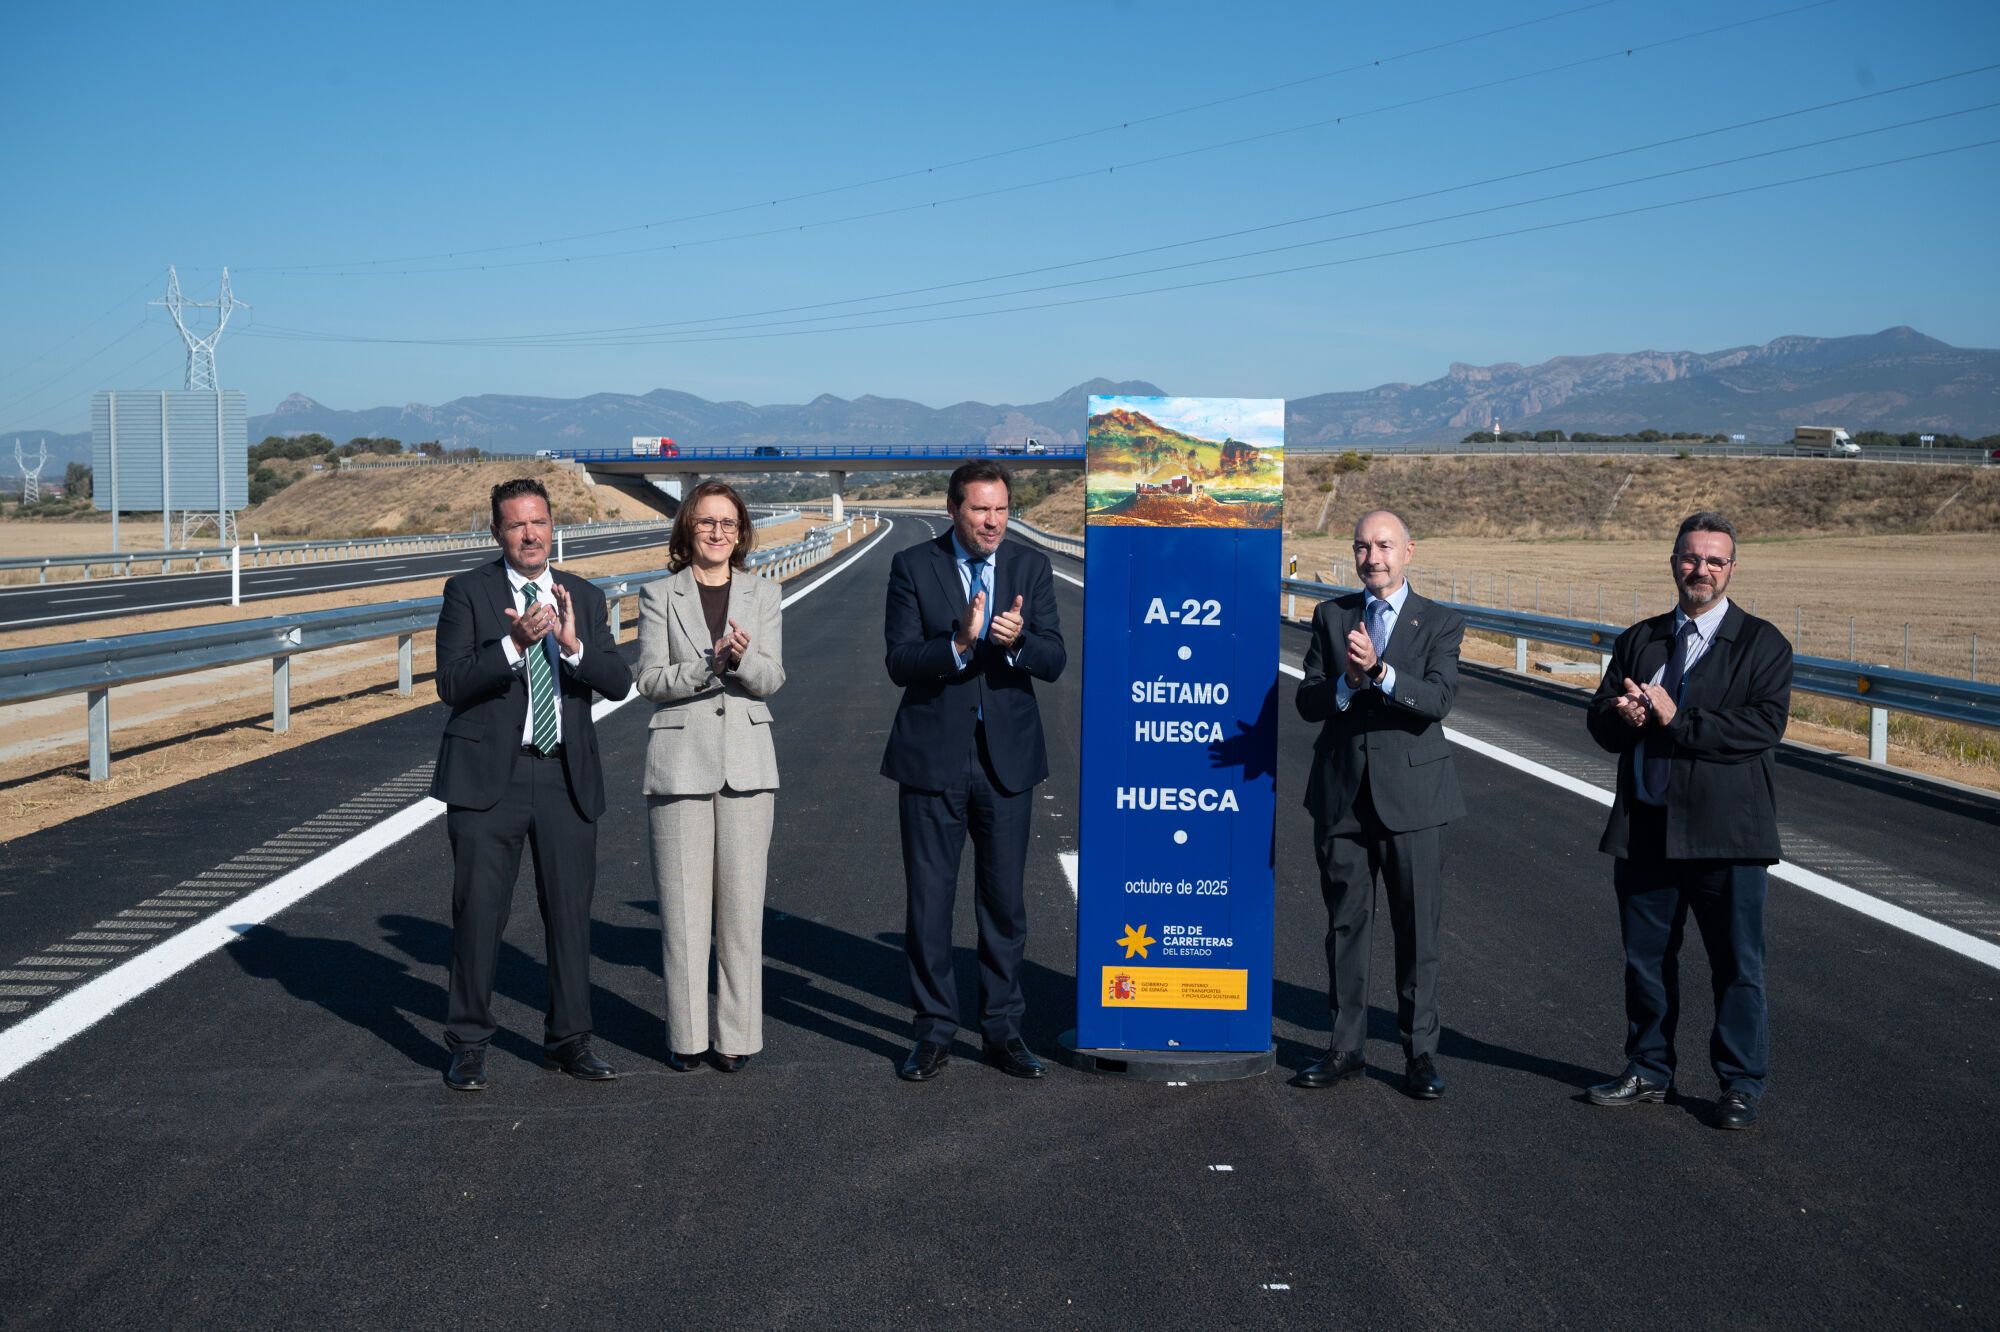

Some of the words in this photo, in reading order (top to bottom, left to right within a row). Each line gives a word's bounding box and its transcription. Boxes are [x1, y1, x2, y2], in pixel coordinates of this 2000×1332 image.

[1143, 597, 1222, 626] A-22
[1131, 675, 1229, 705] SIÉTAMO
[1135, 720, 1224, 743] HUESCA
[1116, 786, 1240, 812] HUESCA
[1125, 878, 1173, 894] octubre
[1176, 879, 1193, 895] de
[1196, 880, 1228, 896] 2025
[1163, 925, 1186, 935] RED
[1187, 926, 1203, 936] DE
[1163, 936, 1233, 947] CARRETERAS
[1163, 948, 1178, 956] DEL
[1180, 948, 1212, 957] ESTADO
